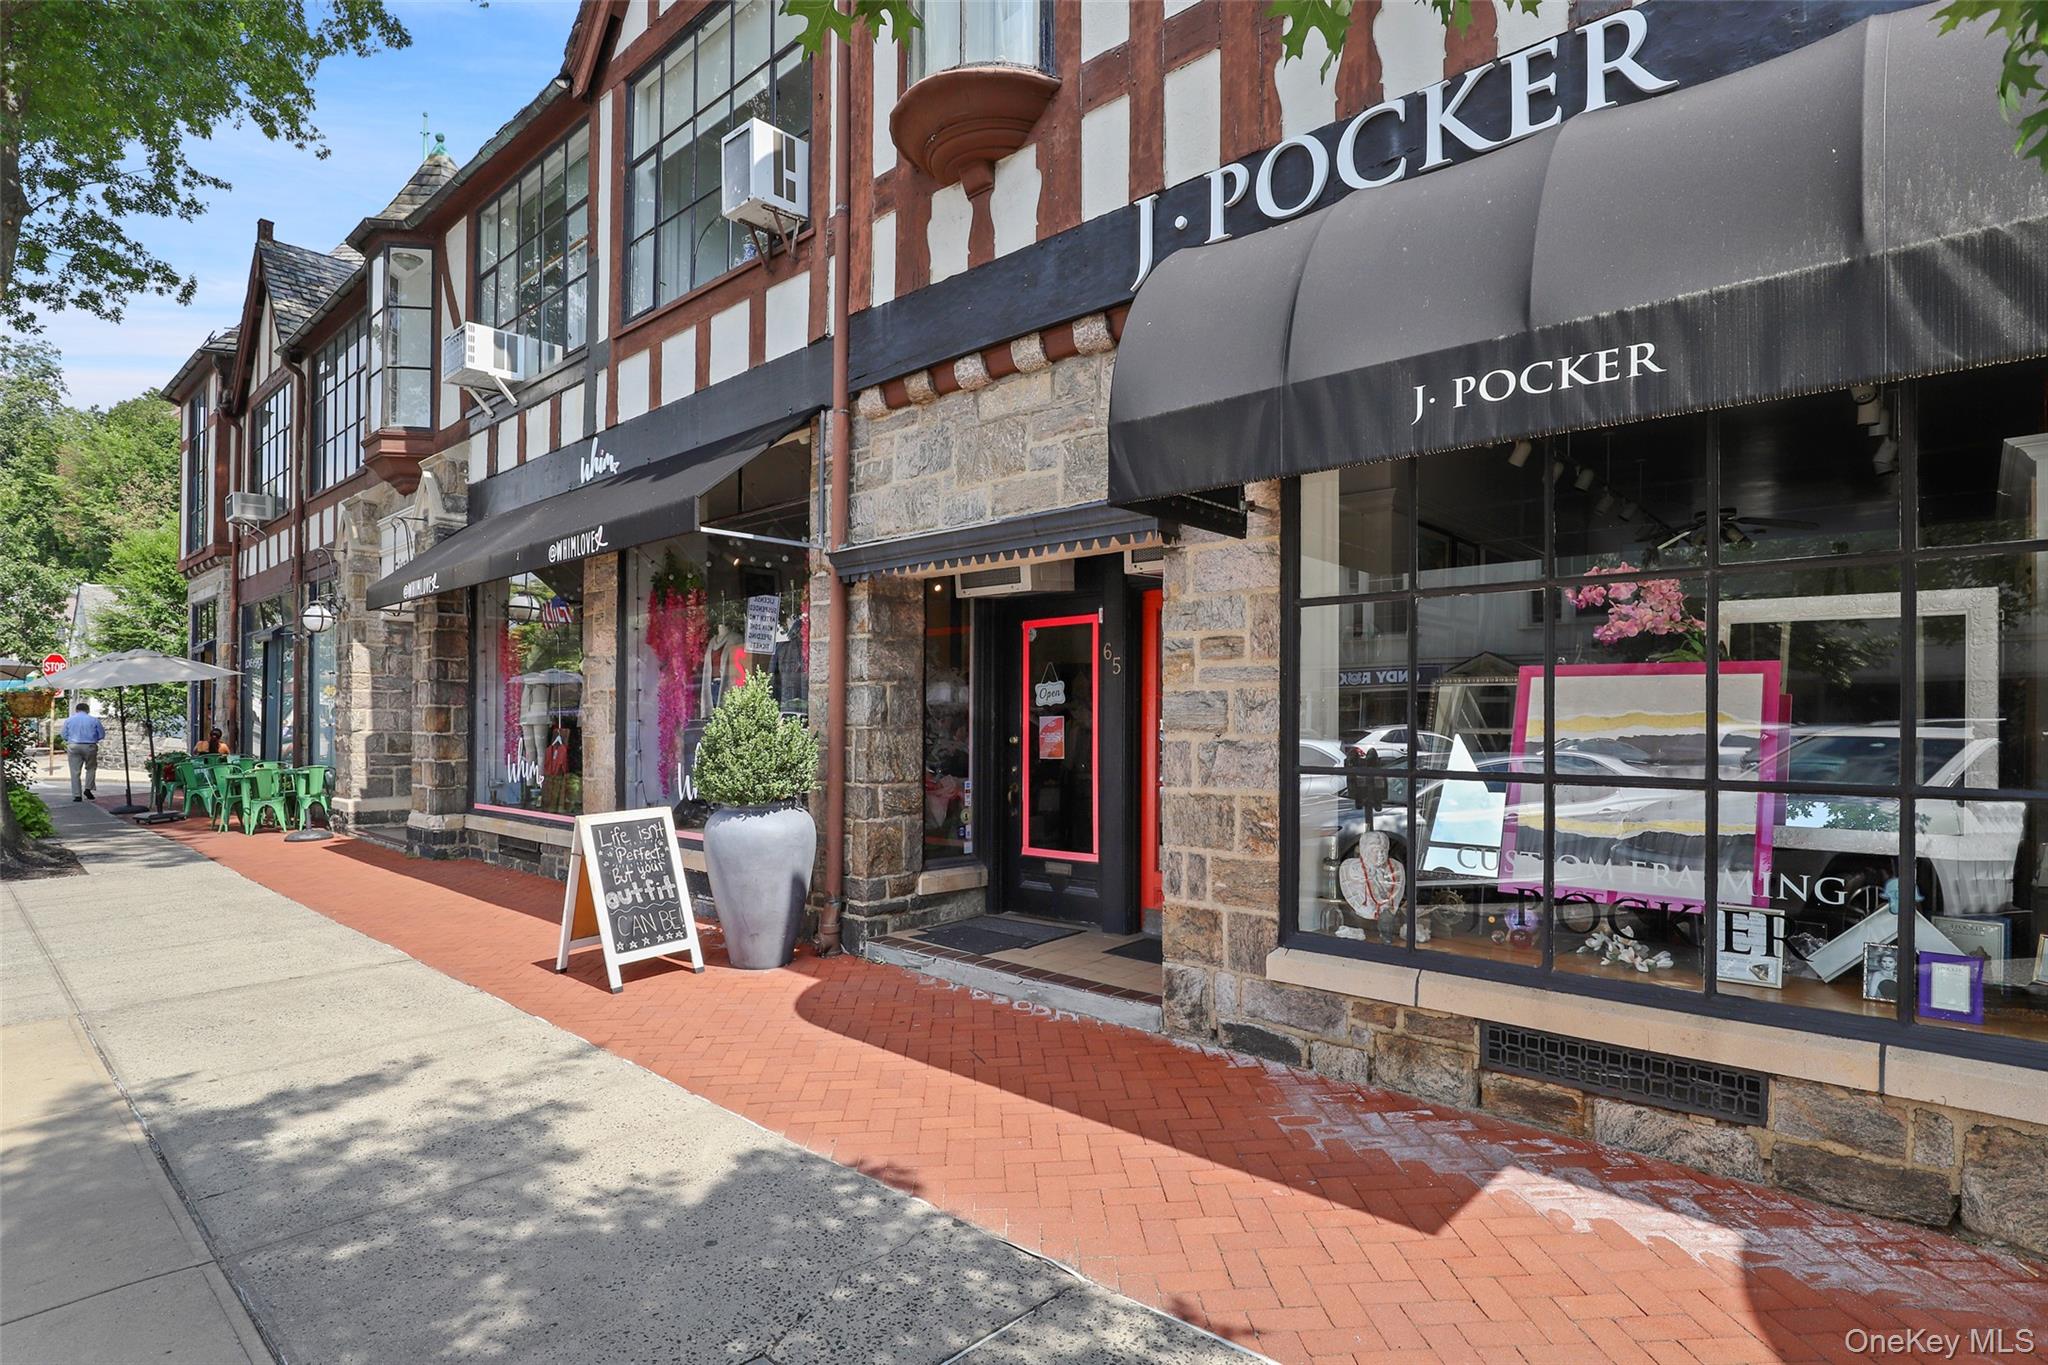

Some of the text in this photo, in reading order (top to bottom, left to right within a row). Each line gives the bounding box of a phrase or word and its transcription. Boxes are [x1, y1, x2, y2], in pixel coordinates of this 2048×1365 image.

[1204, 9, 1680, 246] POCKER
[1452, 342, 1667, 410] POCKER
[44, 662, 66, 672] STOP
[1039, 687, 1061, 701] Open
[598, 826, 631, 847] Life
[612, 860, 665, 885] But your
[1457, 846, 1615, 885] CUSTOM
[1629, 860, 1848, 906] FRAMING
[617, 907, 686, 937] CAN BE!
[1512, 887, 1814, 963] POCKER
